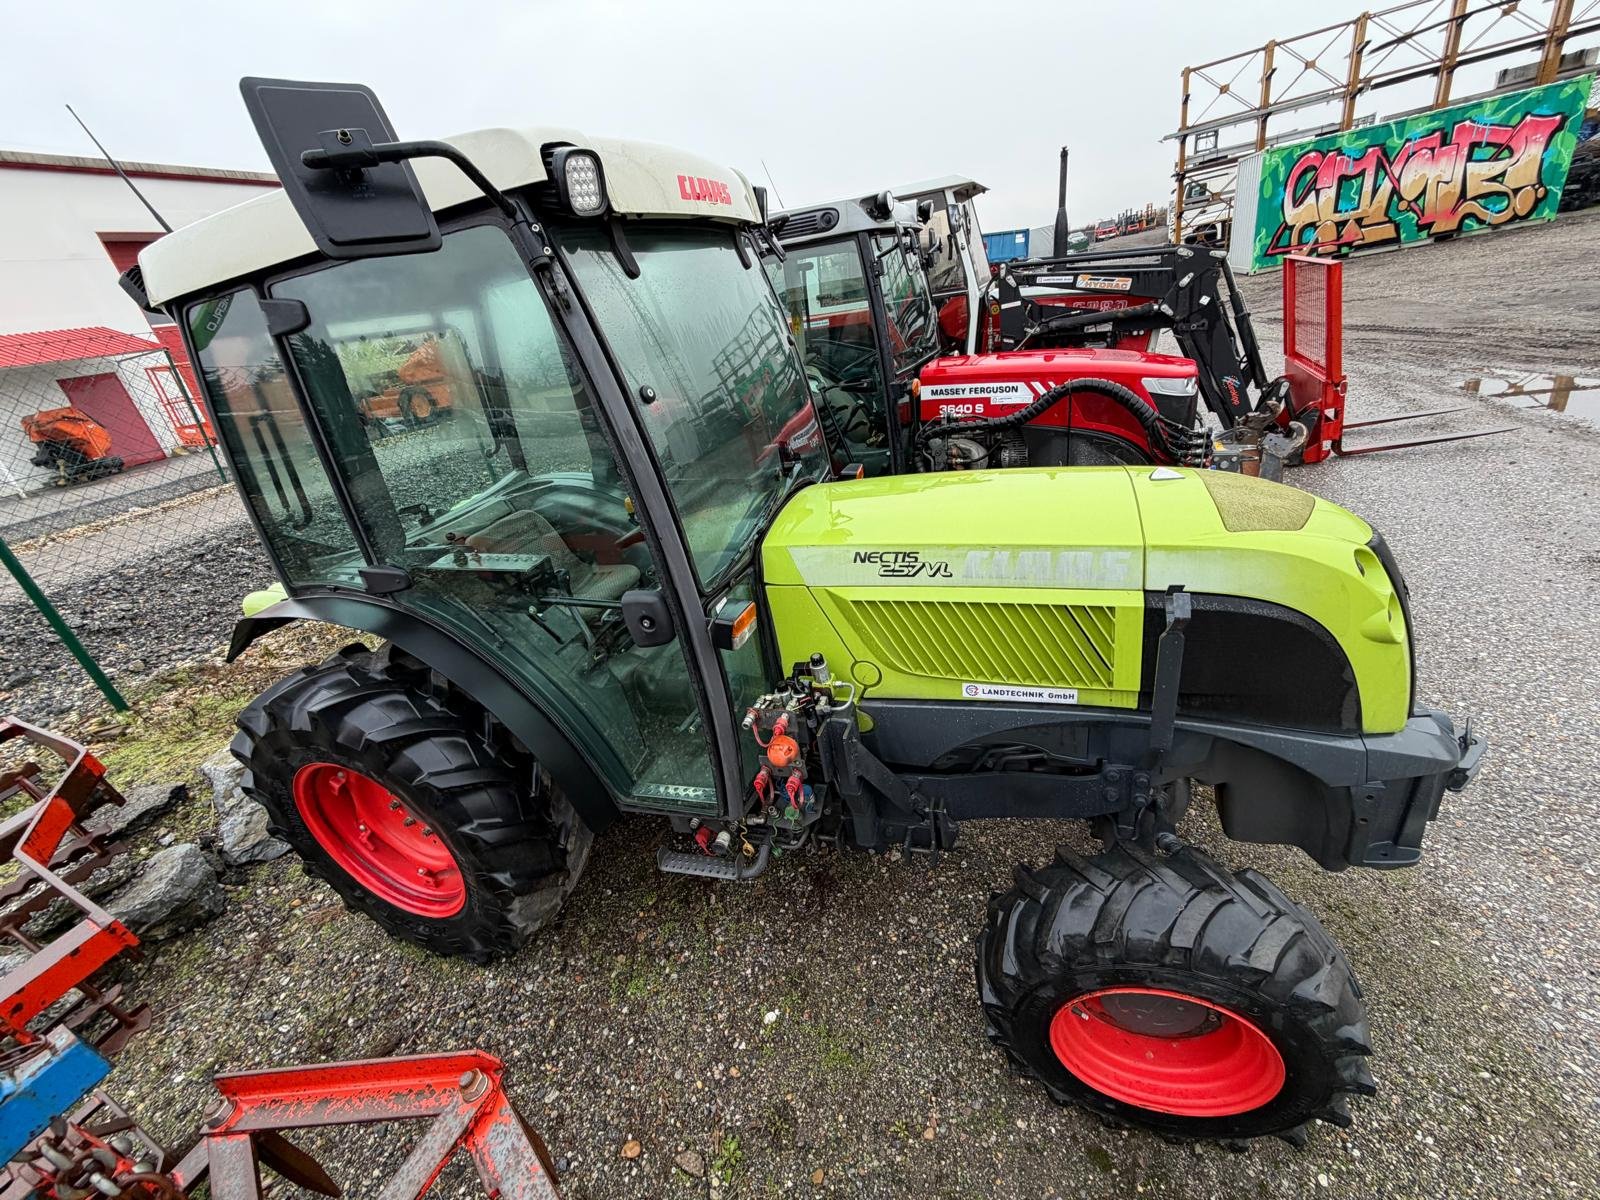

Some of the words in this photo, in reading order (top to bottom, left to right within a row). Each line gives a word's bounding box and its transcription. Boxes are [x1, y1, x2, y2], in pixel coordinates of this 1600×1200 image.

[677, 174, 732, 205] CLAAS
[930, 387, 966, 396] MASSEY
[968, 385, 1018, 394] FERGUSON
[939, 404, 972, 414] 3640
[975, 404, 984, 413] S
[853, 551, 919, 563] NECTIS
[962, 551, 1131, 581] CLAAS
[982, 688, 1044, 699] LANDTECHNIK
[1048, 692, 1075, 700] GmbH
